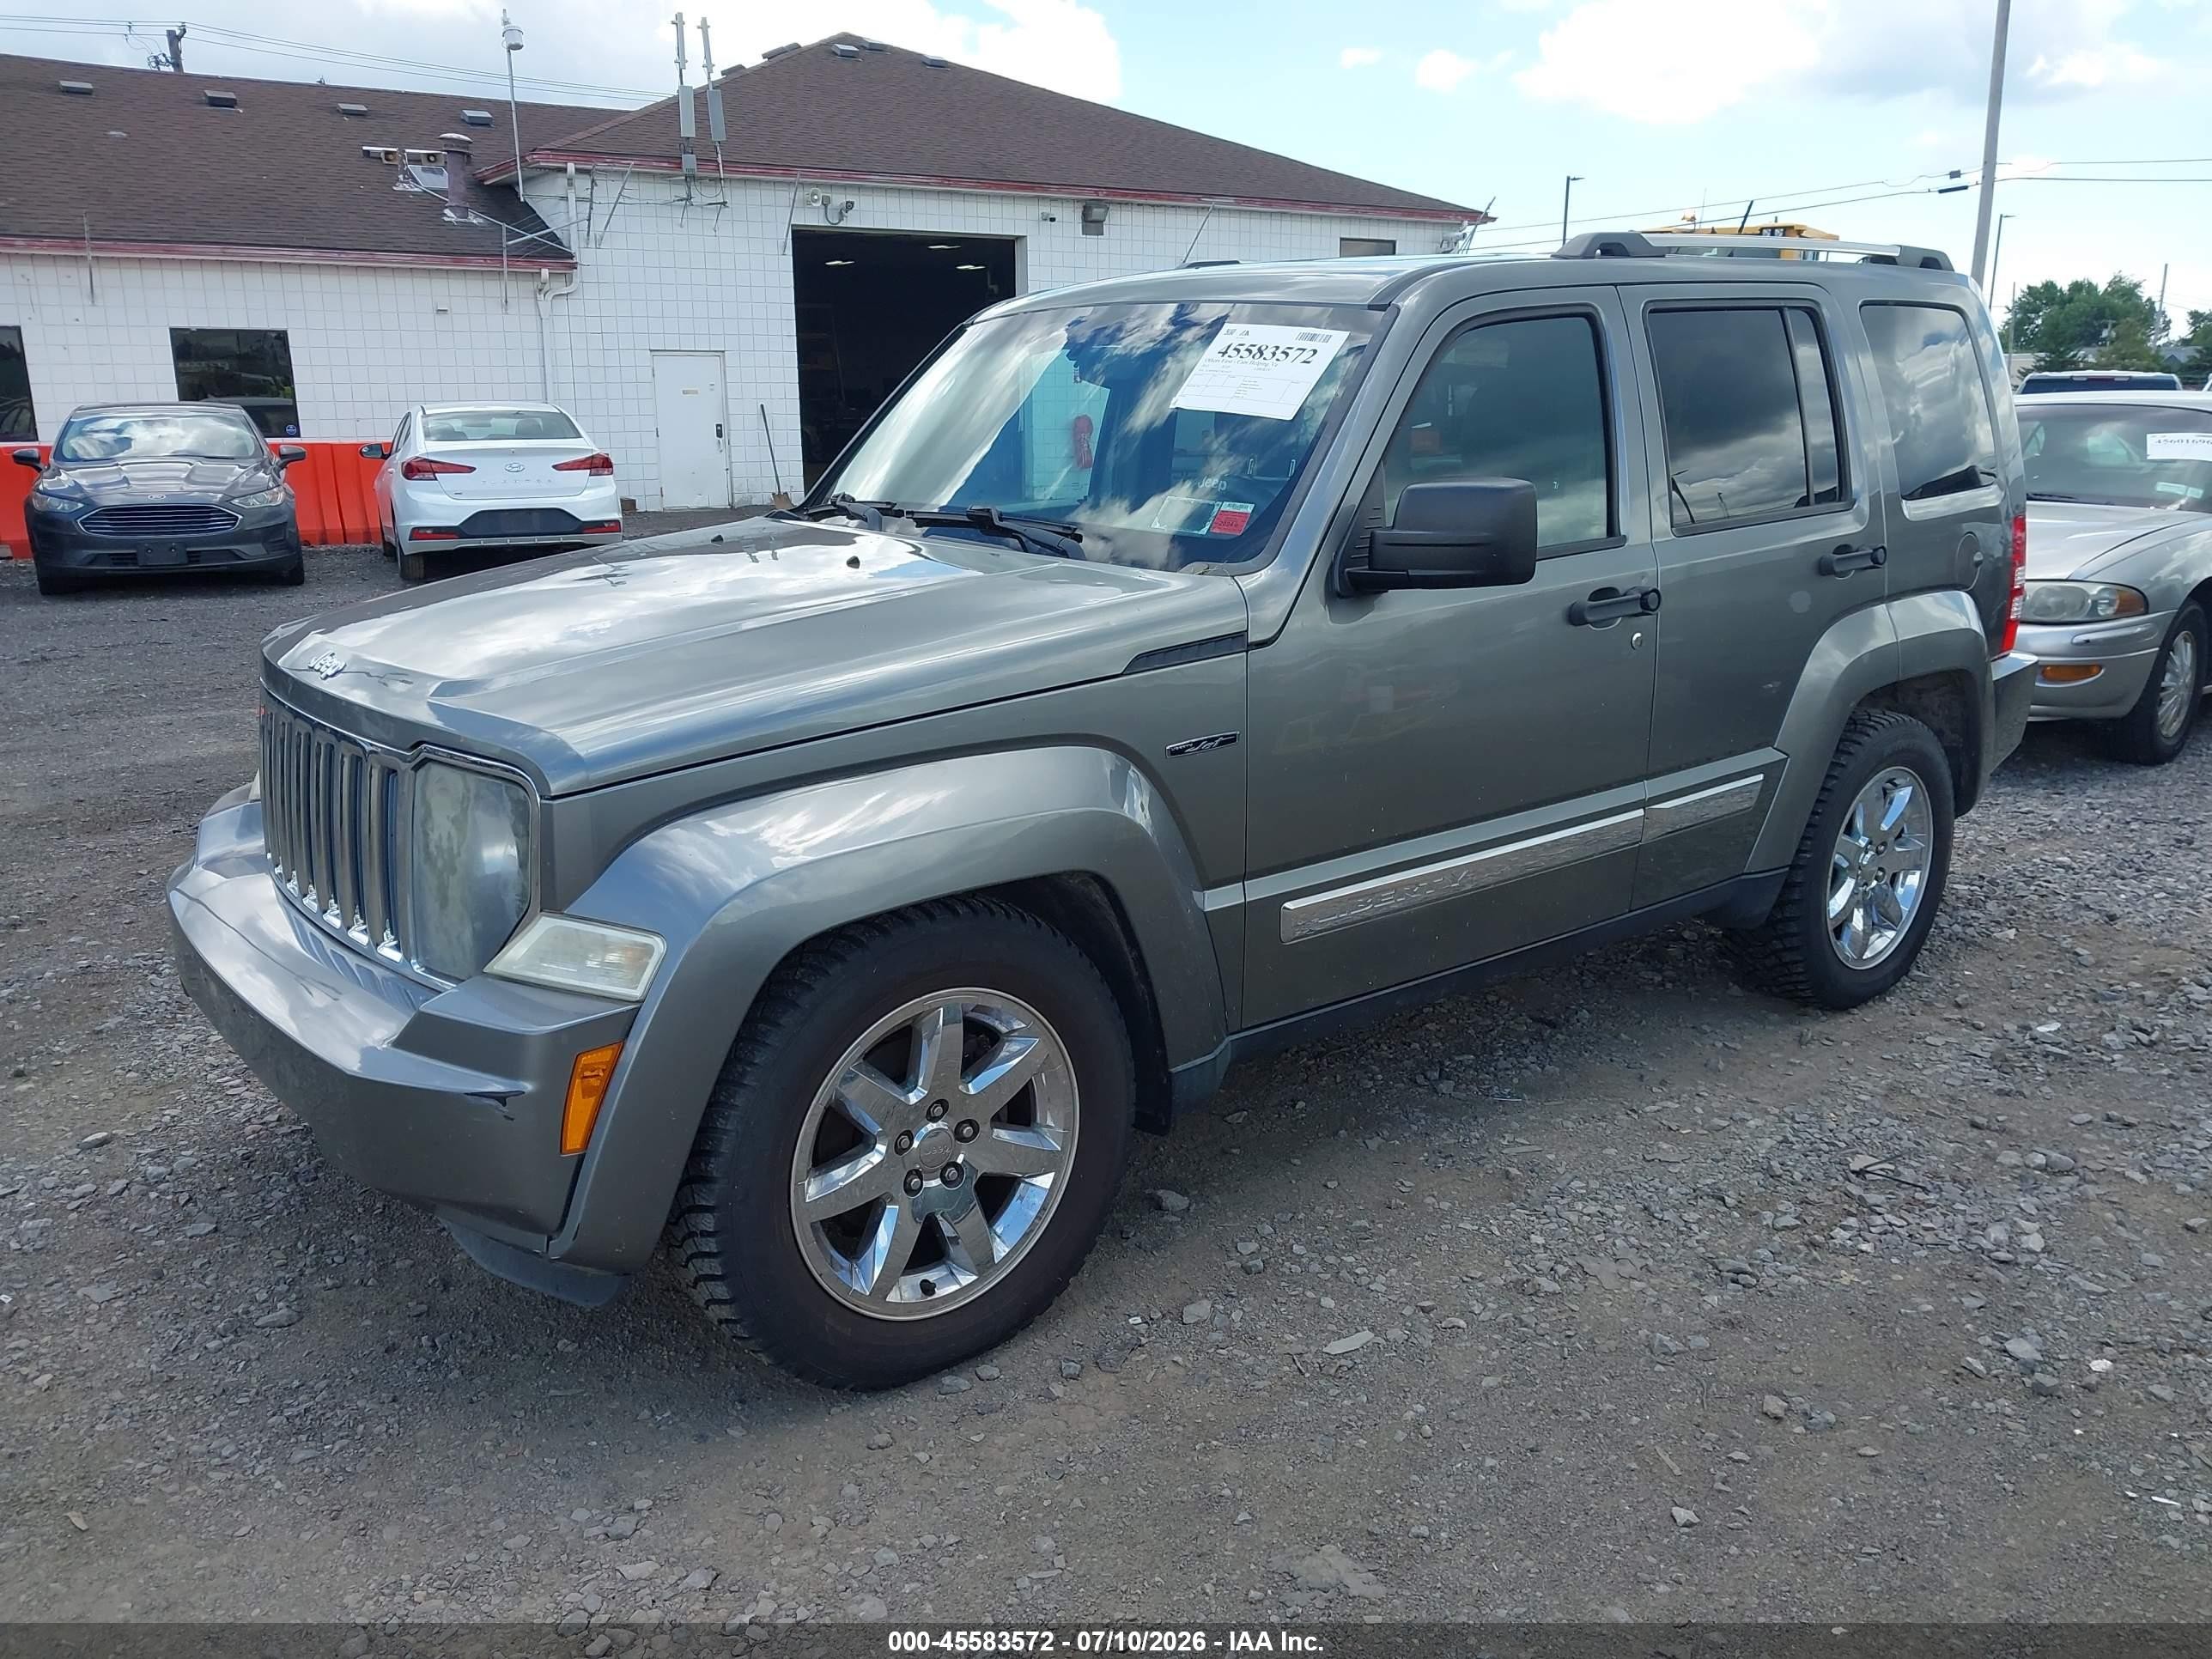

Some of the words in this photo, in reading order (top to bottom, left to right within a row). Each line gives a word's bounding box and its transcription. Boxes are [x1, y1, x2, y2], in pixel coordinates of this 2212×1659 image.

[1218, 343, 1318, 364] 45583572
[1197, 475, 1227, 492] Jeep
[307, 651, 347, 680] Jeep
[1317, 869, 1469, 925] LIBERTY
